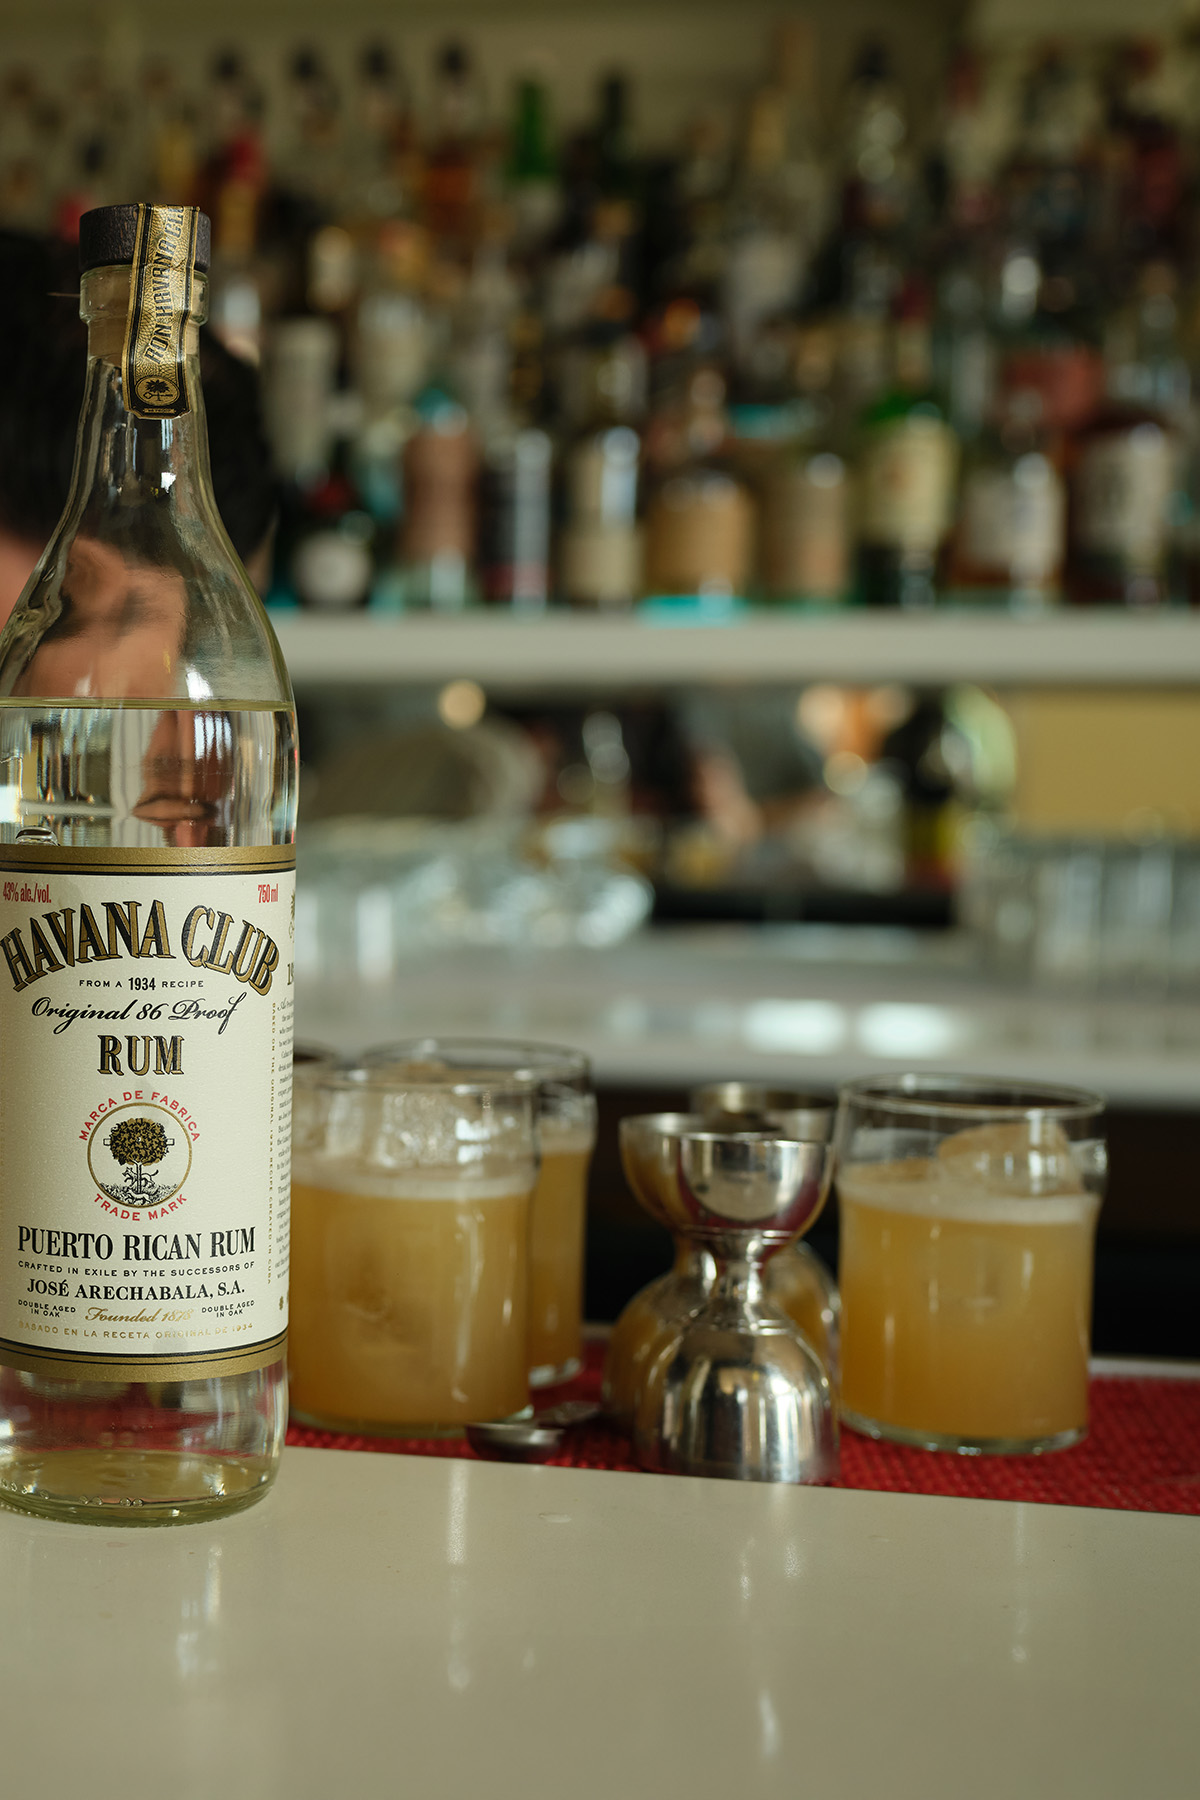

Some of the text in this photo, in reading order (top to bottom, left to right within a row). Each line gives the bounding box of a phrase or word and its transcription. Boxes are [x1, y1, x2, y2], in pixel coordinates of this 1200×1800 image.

[152, 237, 177, 318] HAVANA
[143, 323, 173, 365] RON
[2, 881, 52, 904] 43% alc./vol.
[258, 883, 270, 903] 750
[181, 904, 280, 996] CLUB
[79, 976, 204, 991] FROM A 1934 RECIPE
[31, 991, 247, 1035] Original 86 Proof
[96, 1034, 185, 1076] RUM
[78, 1090, 201, 1142] MARCA DE FABRICA
[93, 1193, 188, 1221] TRADE MARK
[17, 1225, 114, 1261] PUERTO
[122, 1232, 202, 1262] RICAN
[210, 1226, 257, 1258] RUM
[18, 1260, 63, 1273] CRAFTED
[67, 1266, 79, 1275] IN
[84, 1269, 118, 1277] EXILE
[142, 1269, 165, 1277] THE
[170, 1262, 240, 1277] SUCCESSORS
[243, 1261, 255, 1270] OF
[27, 1278, 245, 1301] JOSÉ ARECHABALA, S.A.
[18, 1299, 76, 1313] DOUBLE AGED
[85, 1306, 194, 1322] Founded 1878
[201, 1299, 255, 1313] DOUBLE AGED
[18, 1321, 59, 1334] BASADO
[64, 1328, 78, 1336] EN
[83, 1329, 97, 1337] LA
[103, 1330, 150, 1339] RECETA
[155, 1329, 211, 1339] ORIGINAL
[215, 1326, 228, 1335] DE
